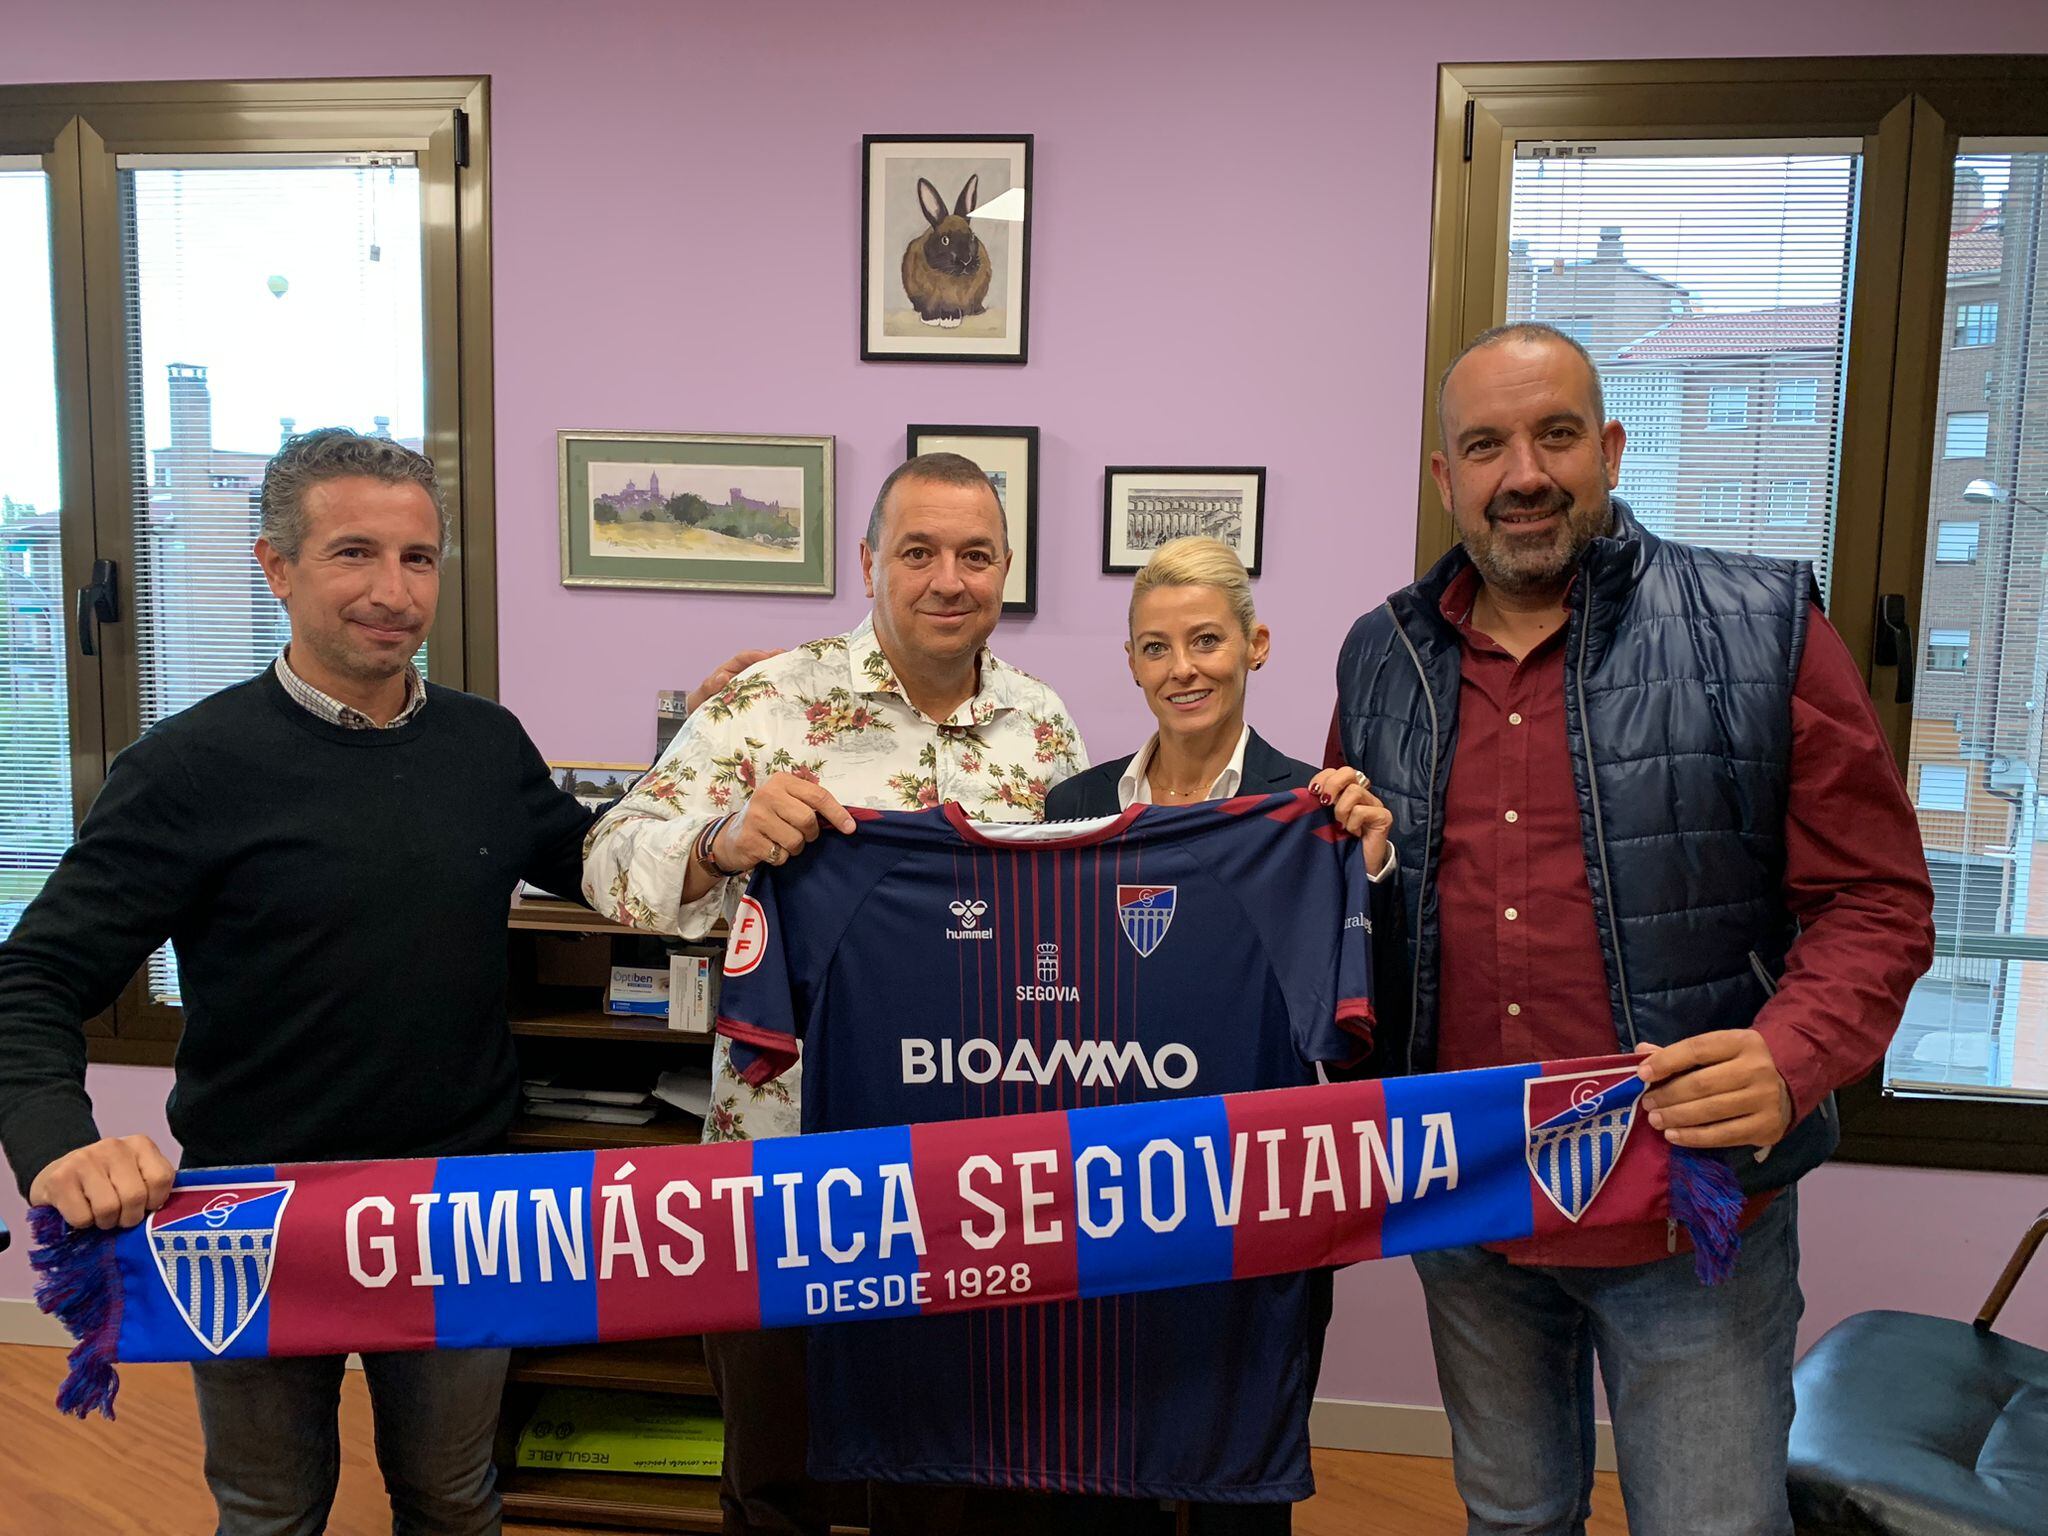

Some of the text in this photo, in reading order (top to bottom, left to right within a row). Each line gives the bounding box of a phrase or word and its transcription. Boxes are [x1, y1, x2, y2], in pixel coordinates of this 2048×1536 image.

[946, 927, 993, 940] hummel
[613, 970, 653, 984] Optiben
[1016, 985, 1080, 1002] SEGOVIA
[345, 1112, 1458, 1288] GIMNÁSTICA SEGOVIANA
[806, 1263, 1032, 1316] DESDE 1928
[527, 1450, 610, 1465] REGULABLE
